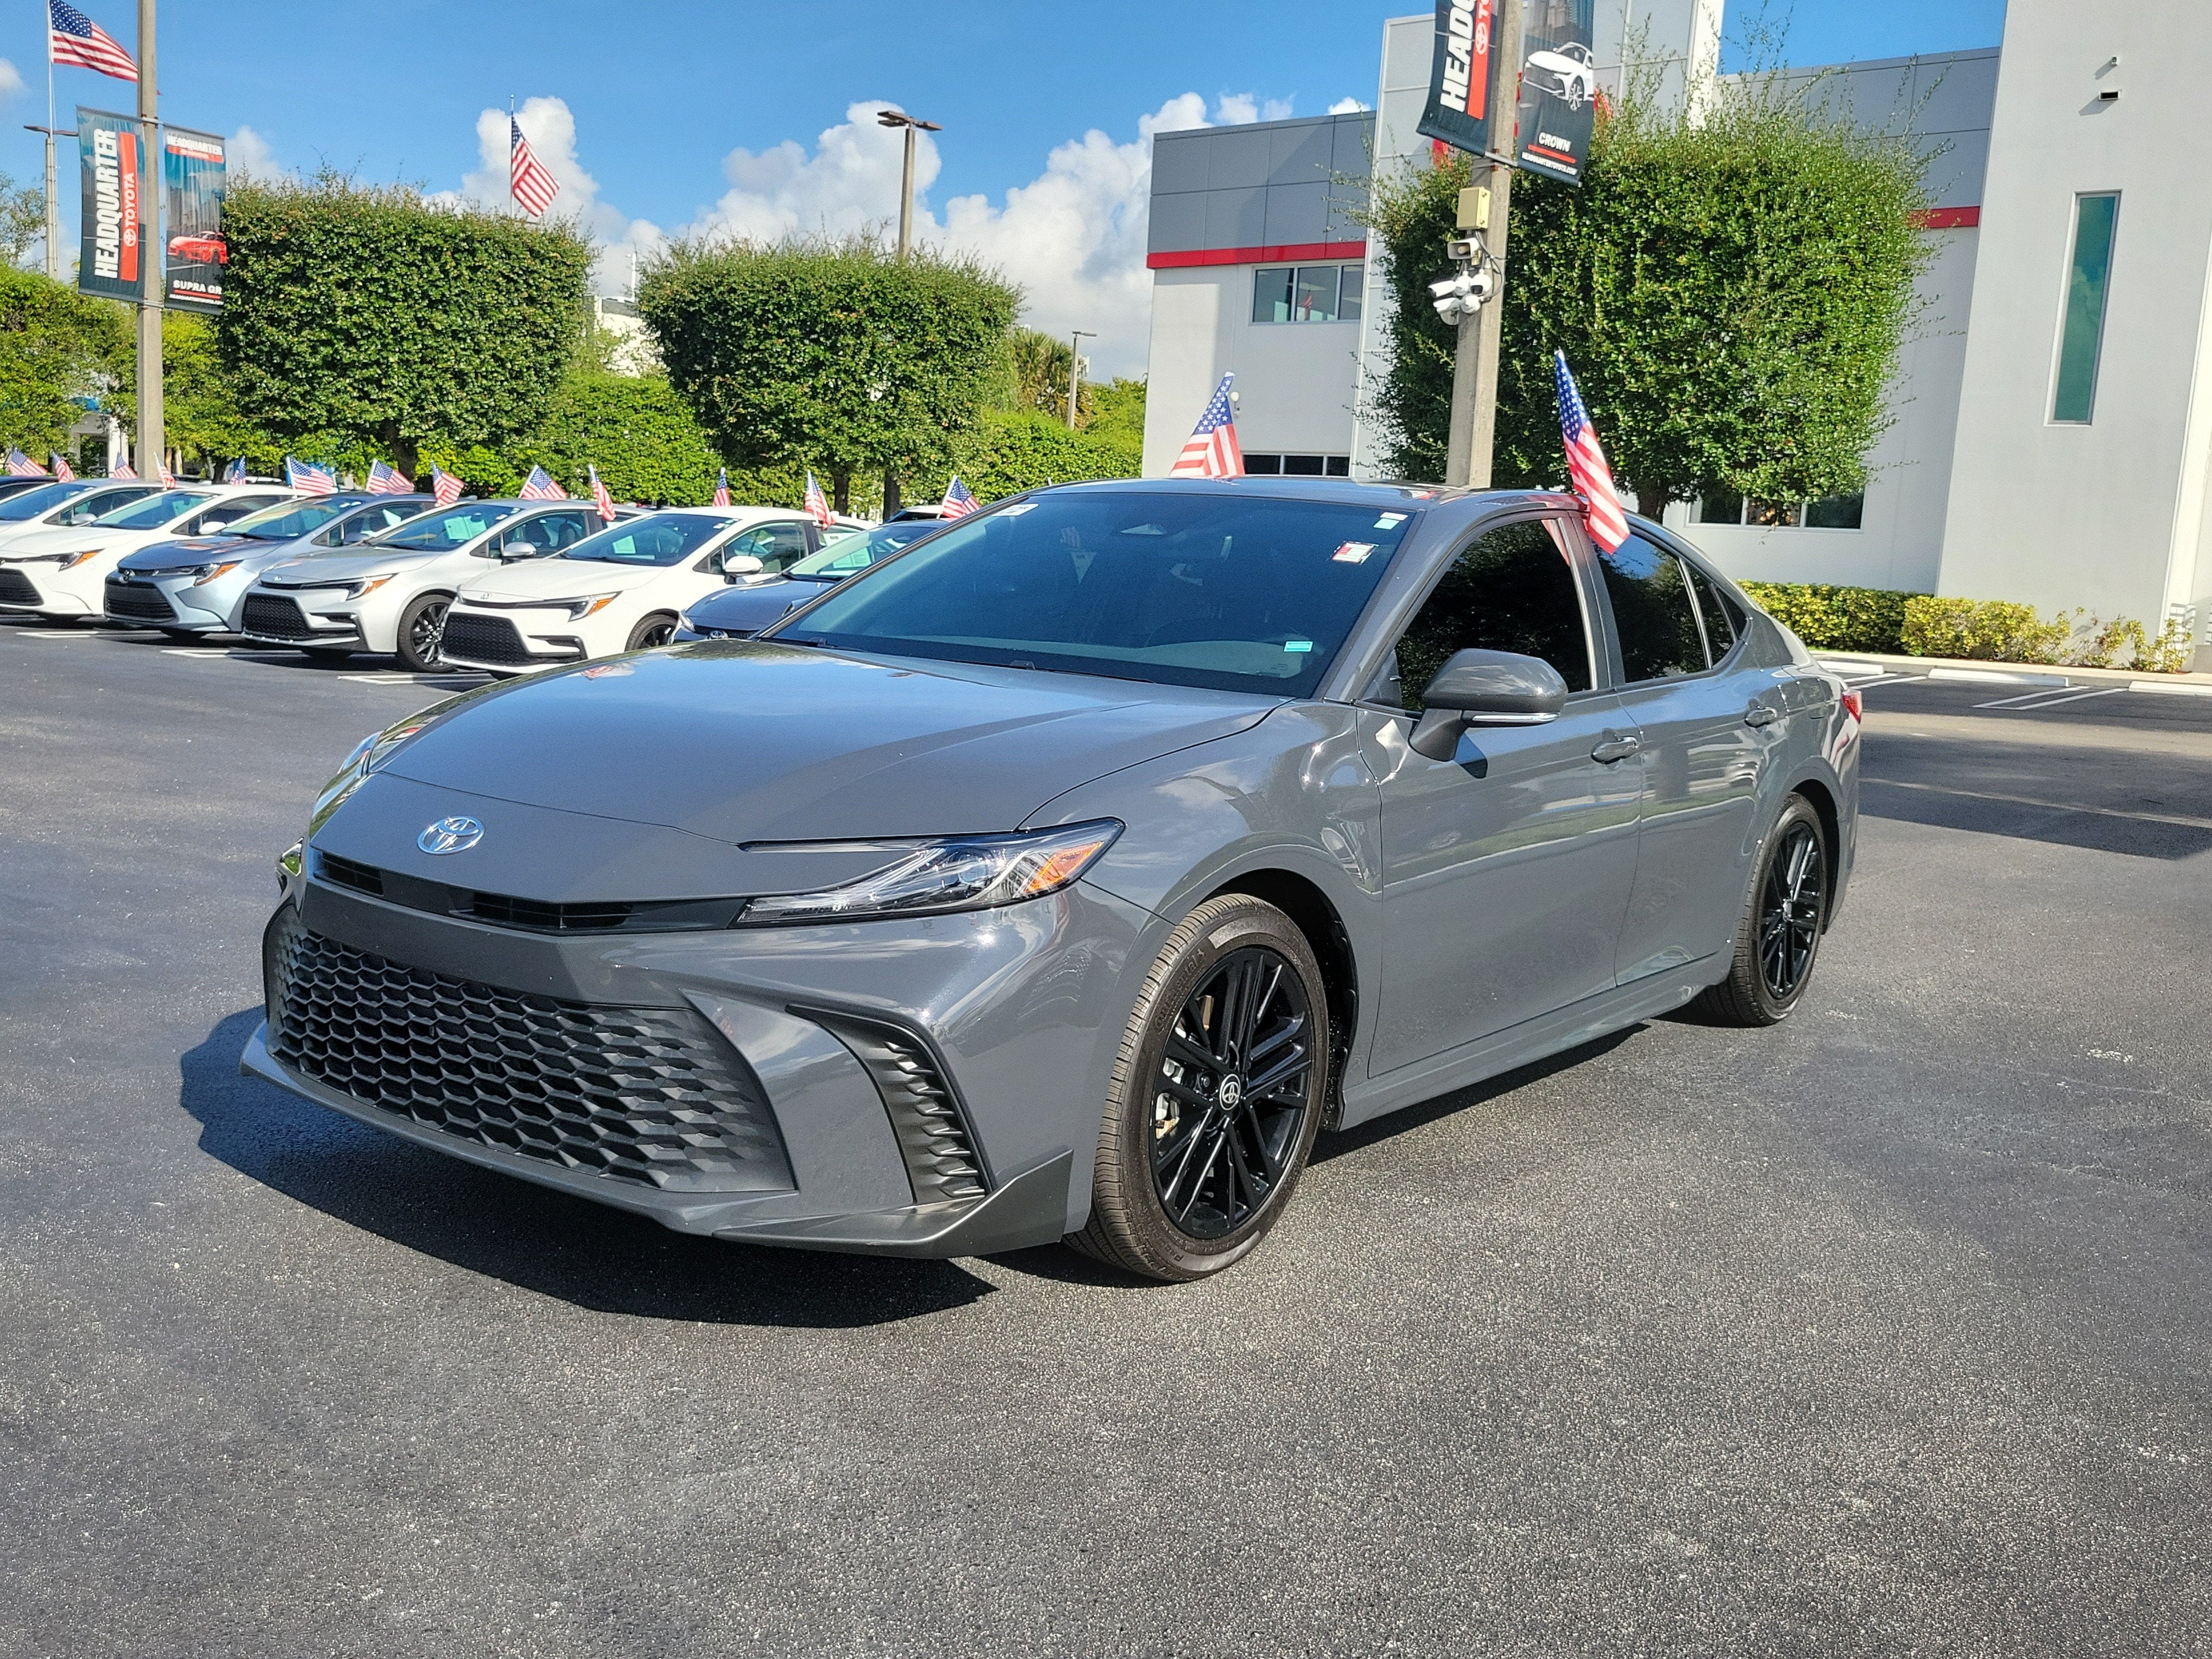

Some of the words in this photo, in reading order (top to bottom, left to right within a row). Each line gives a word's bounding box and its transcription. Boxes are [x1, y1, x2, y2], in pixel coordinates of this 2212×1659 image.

[1538, 132, 1571, 153] CROWN
[94, 128, 123, 279] HEADQUARTER
[124, 172, 136, 227] TOYOTA
[173, 280, 206, 292] SUPRA
[207, 285, 222, 295] GR
